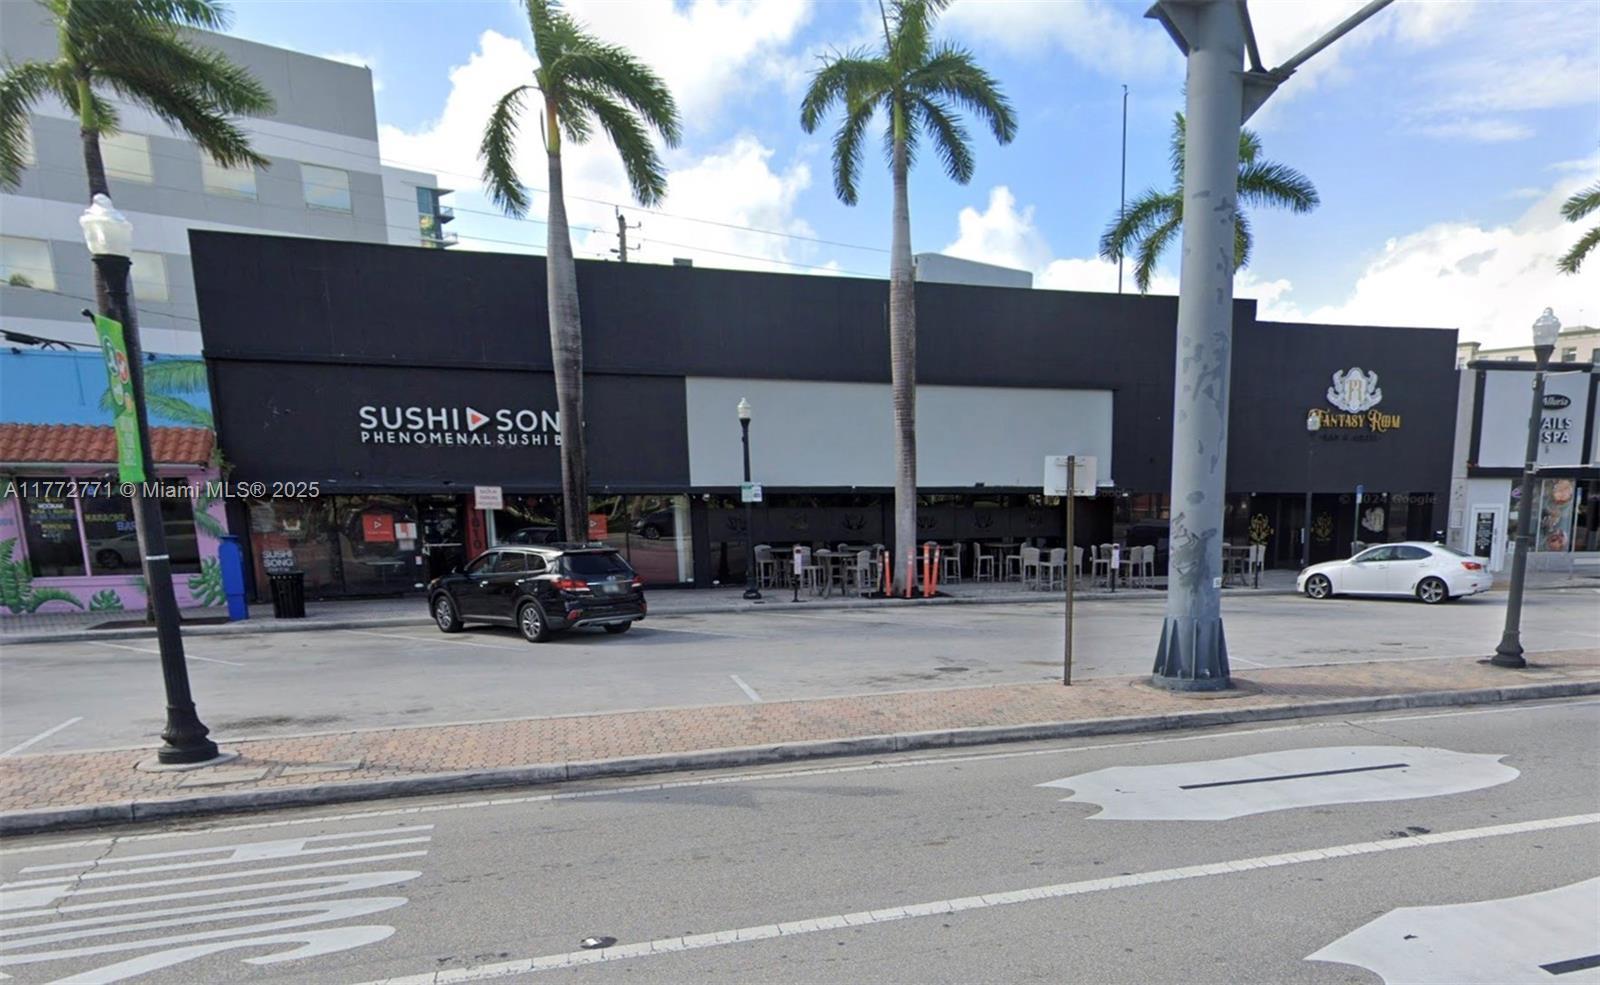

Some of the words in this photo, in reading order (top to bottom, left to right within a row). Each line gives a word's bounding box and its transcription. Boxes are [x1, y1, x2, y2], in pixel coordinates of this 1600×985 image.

[359, 406, 459, 431] SUSHI
[496, 409, 561, 432] SON
[1541, 417, 1572, 430] AILS
[361, 431, 491, 445] PHENOMENAL
[497, 433, 548, 446] SUSHI
[1541, 431, 1569, 444] SPA
[263, 558, 294, 567] SONG
